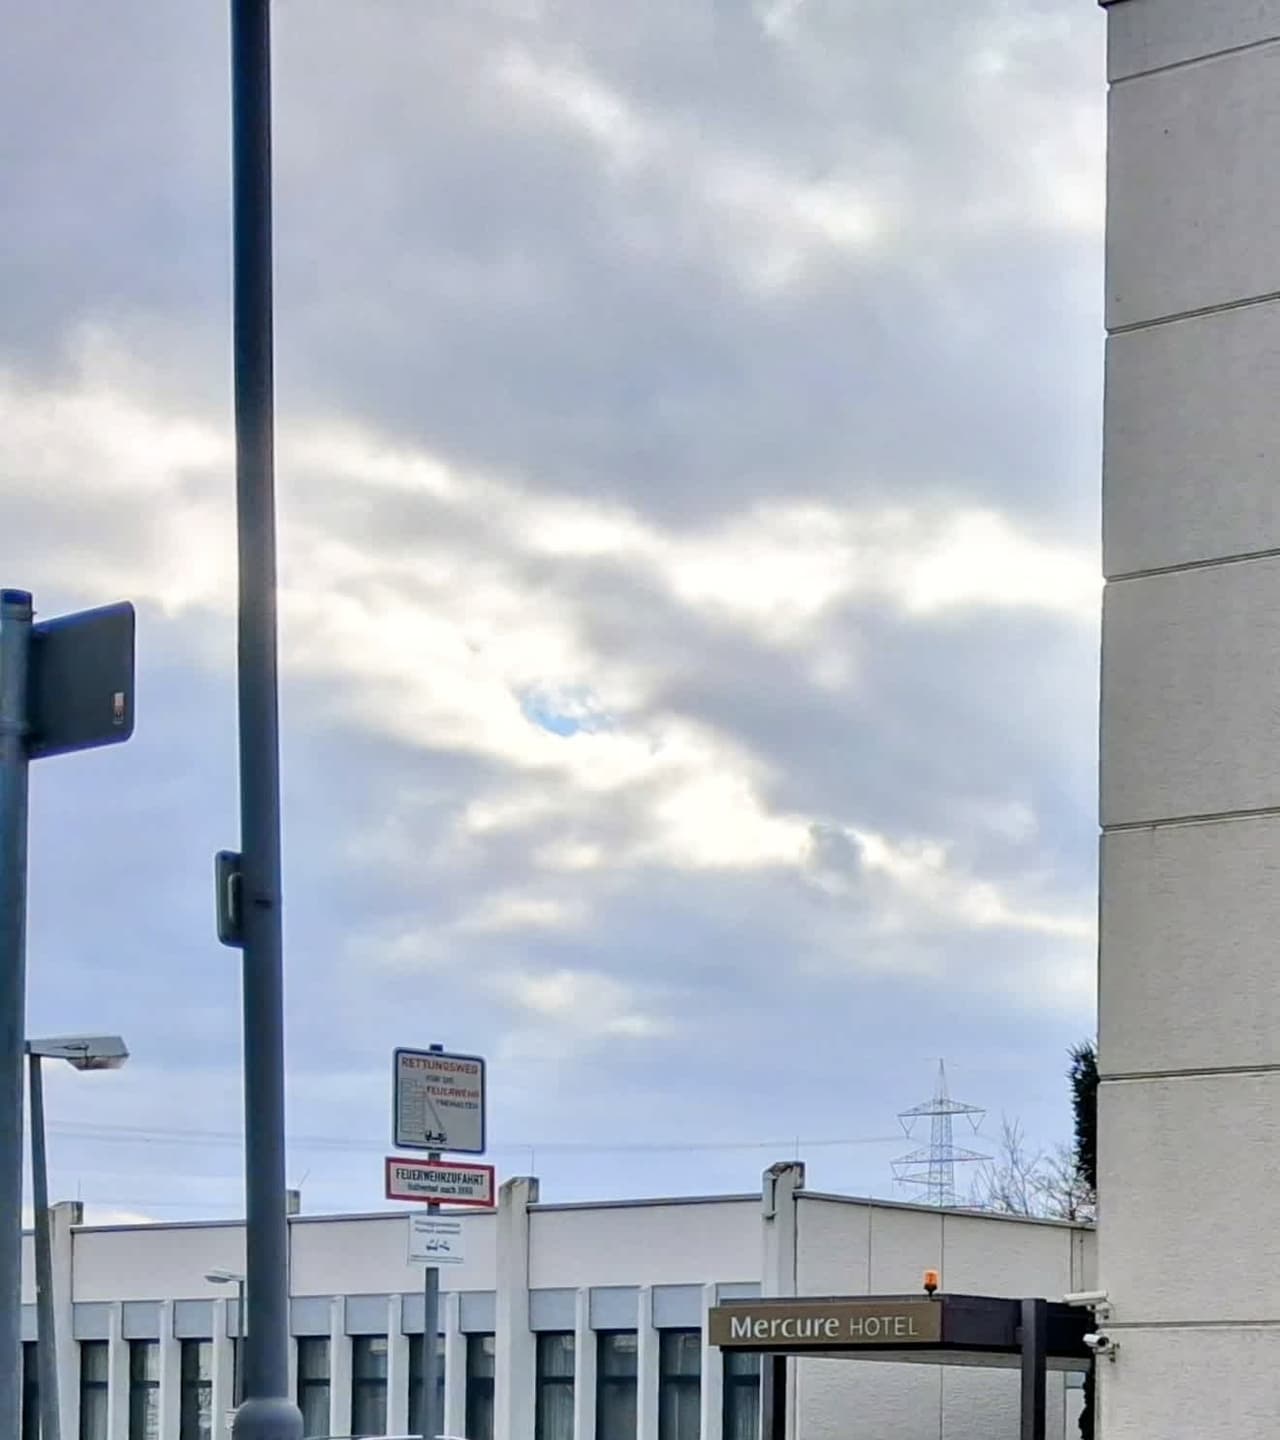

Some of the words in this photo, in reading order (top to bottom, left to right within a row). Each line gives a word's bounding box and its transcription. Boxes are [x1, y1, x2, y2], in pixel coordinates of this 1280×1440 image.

[396, 1167, 485, 1186] FEUERWEHRZUFAHRT
[730, 1315, 840, 1340] Mercure
[850, 1316, 919, 1337] HOTEL
